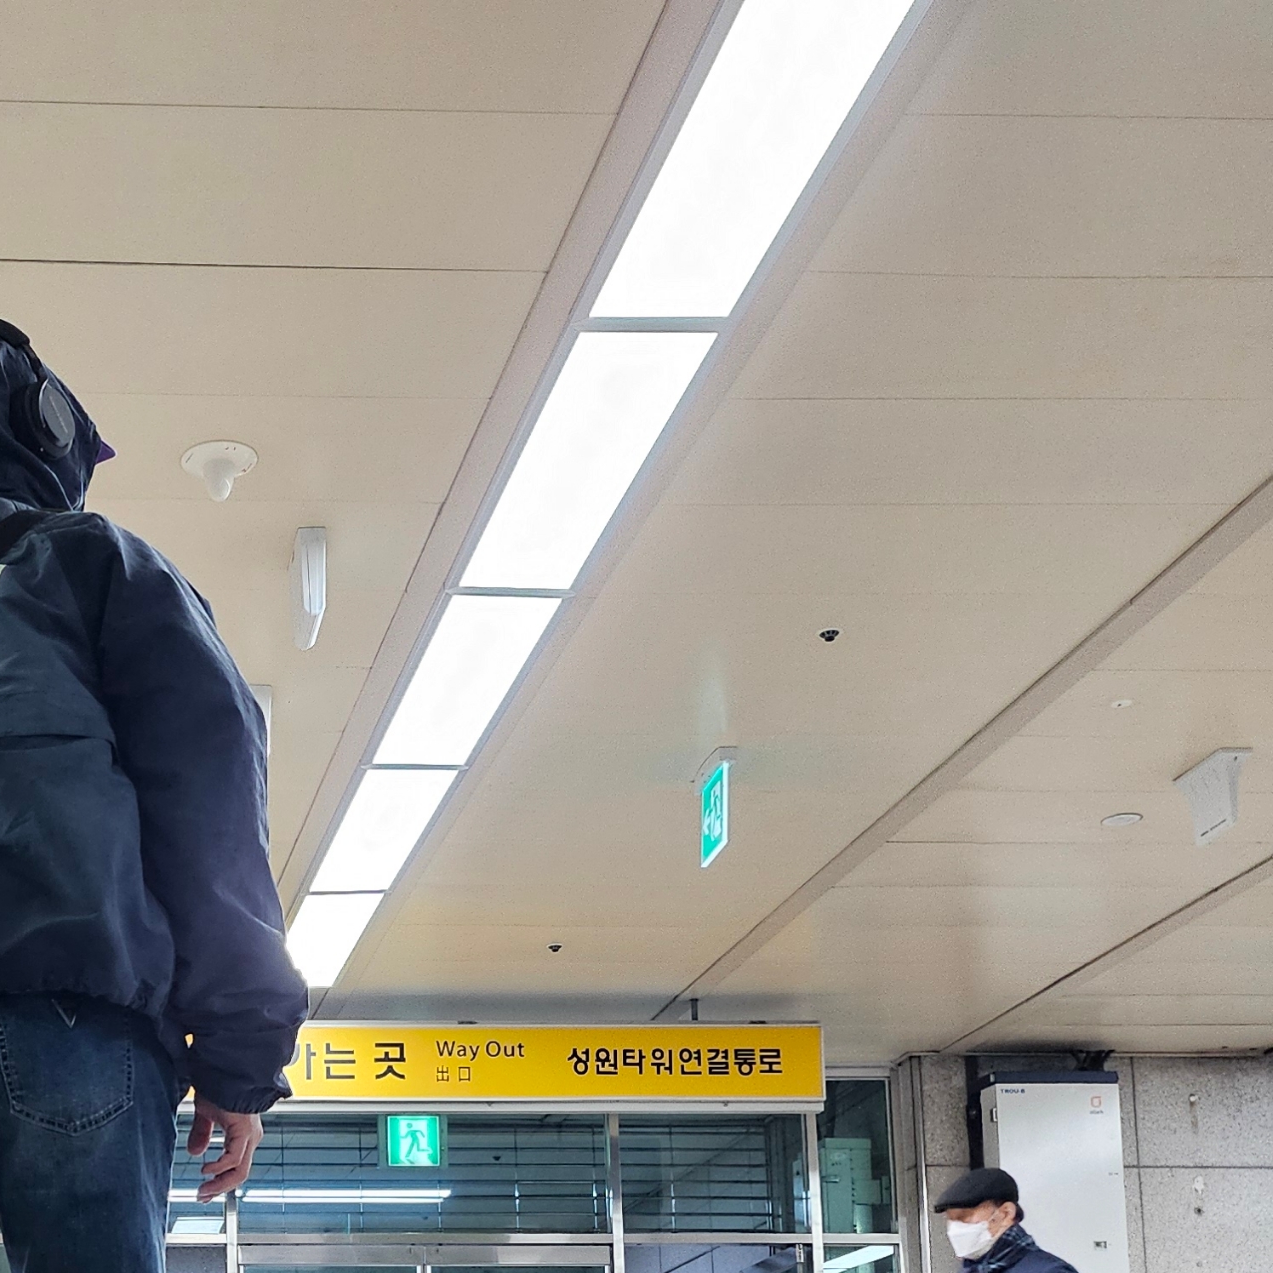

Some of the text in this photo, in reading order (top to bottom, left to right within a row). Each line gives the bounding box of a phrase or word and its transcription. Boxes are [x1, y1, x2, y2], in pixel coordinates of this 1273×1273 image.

[374, 1042, 407, 1080] 곳
[436, 1040, 525, 1062] Way Out
